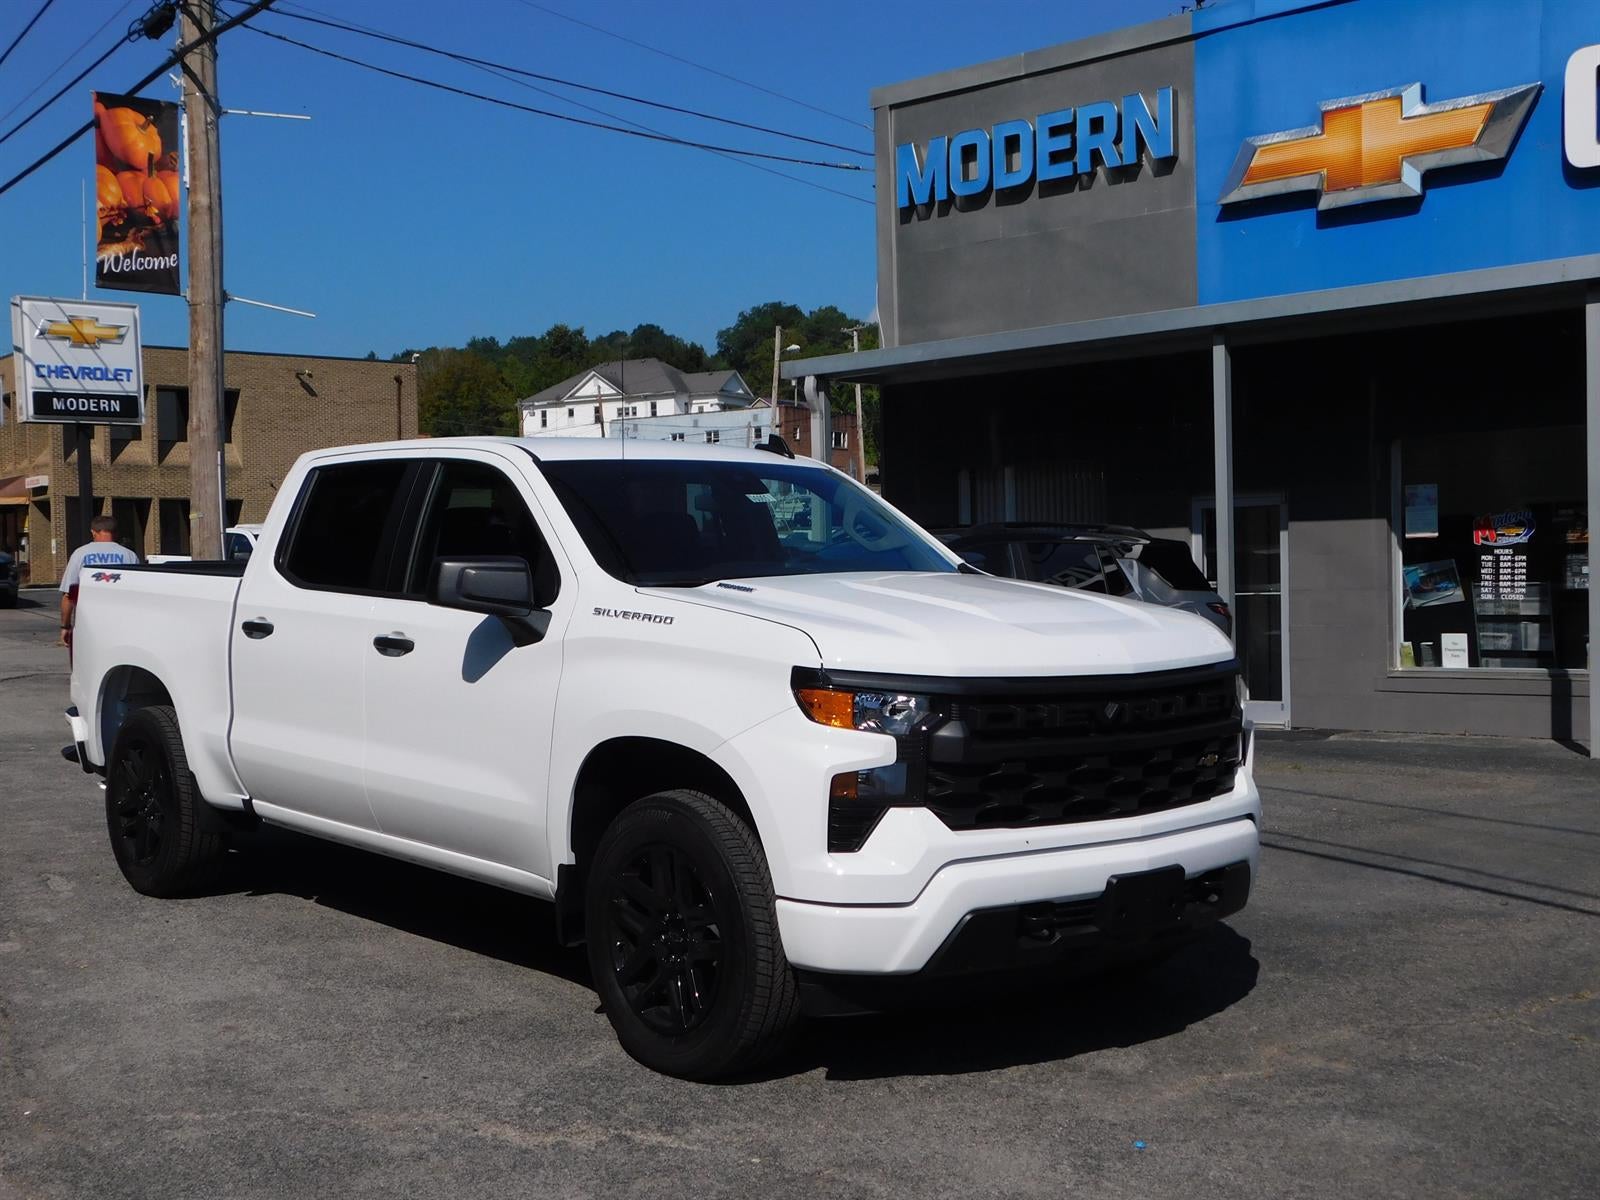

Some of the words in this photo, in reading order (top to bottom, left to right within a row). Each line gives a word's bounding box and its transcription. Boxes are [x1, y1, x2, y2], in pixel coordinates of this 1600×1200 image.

[896, 86, 1174, 208] MODERN
[97, 246, 178, 274] Welcome
[35, 364, 133, 382] CHEVROLET
[52, 397, 120, 412] MODERN
[593, 607, 675, 625] SILVERADO
